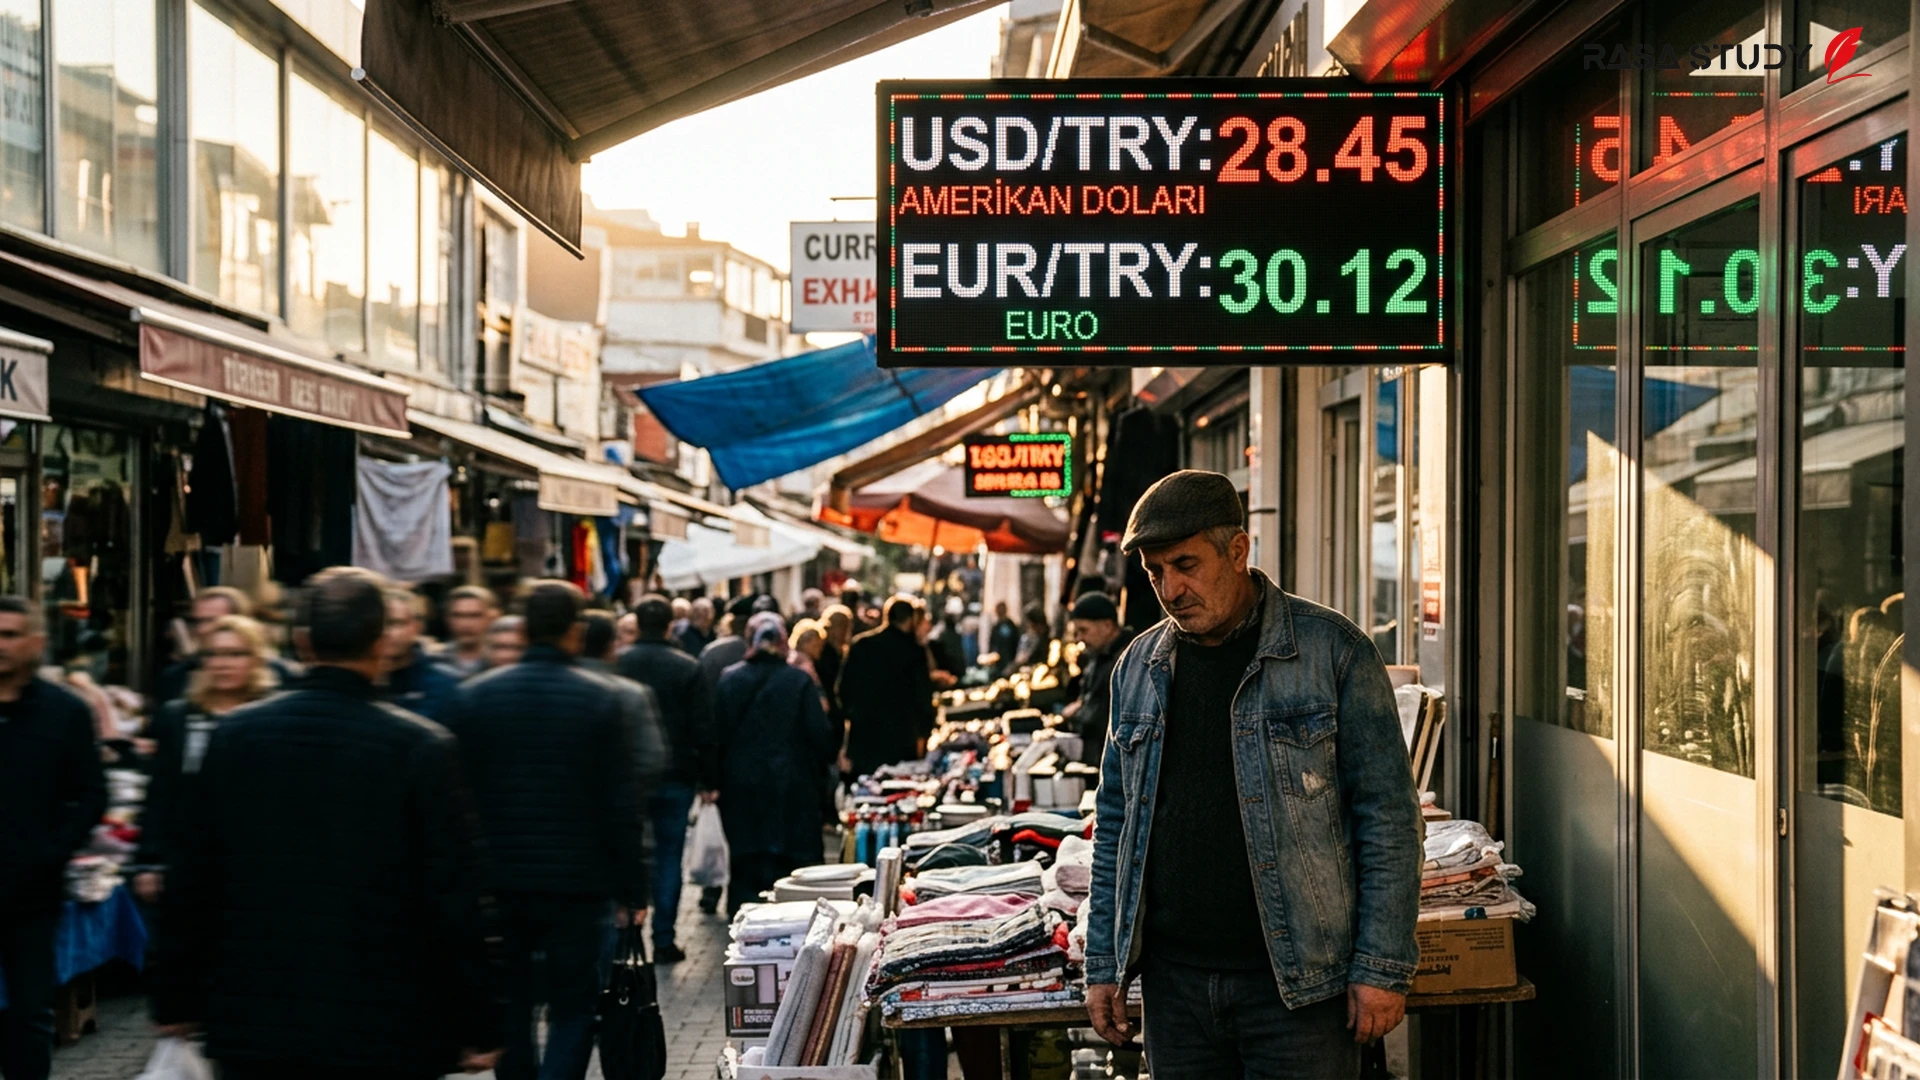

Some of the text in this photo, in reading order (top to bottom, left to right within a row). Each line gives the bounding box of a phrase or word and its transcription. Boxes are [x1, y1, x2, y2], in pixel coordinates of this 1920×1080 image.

[902, 116, 1429, 183] USD/TRY: 28.45
[899, 178, 1206, 216] AMERİKAN DOLARI
[902, 243, 1429, 315] EUR/TRY: 30.12
[1005, 311, 1100, 341] EURO
